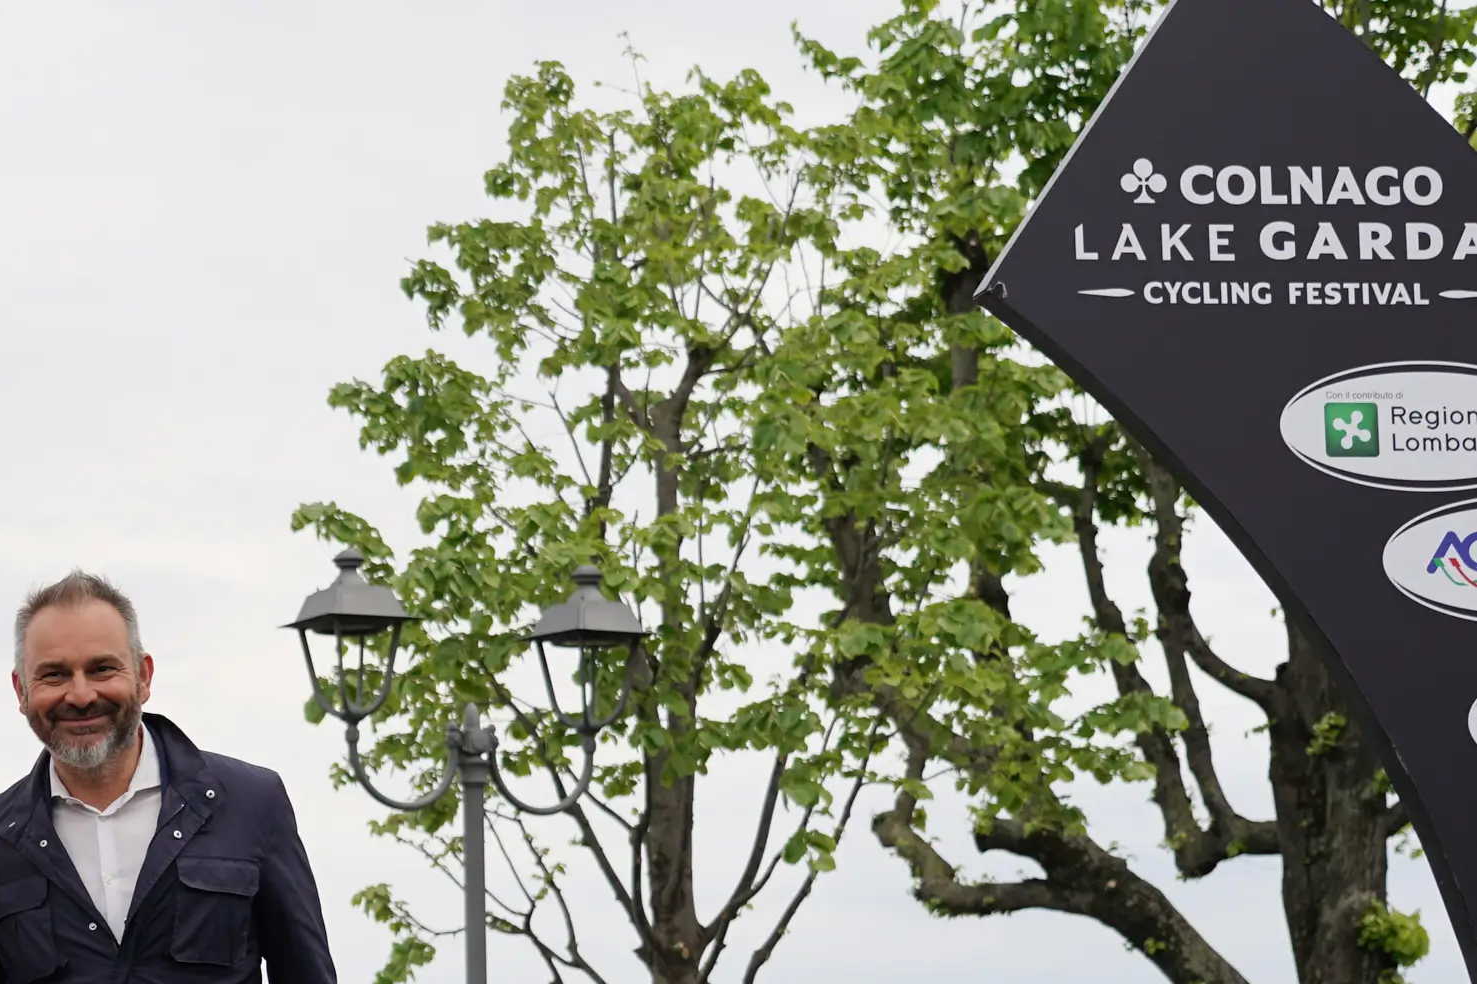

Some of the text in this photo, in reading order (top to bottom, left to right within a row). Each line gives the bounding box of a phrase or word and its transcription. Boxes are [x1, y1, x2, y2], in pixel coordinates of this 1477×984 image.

[1179, 165, 1443, 206] COLNAGO
[1074, 222, 1477, 261] LAKE GARDA
[1143, 282, 1430, 306] CYCLING FESTIVAL
[1325, 391, 1343, 400] Con
[1351, 391, 1394, 400] contributo
[1395, 391, 1404, 400] di
